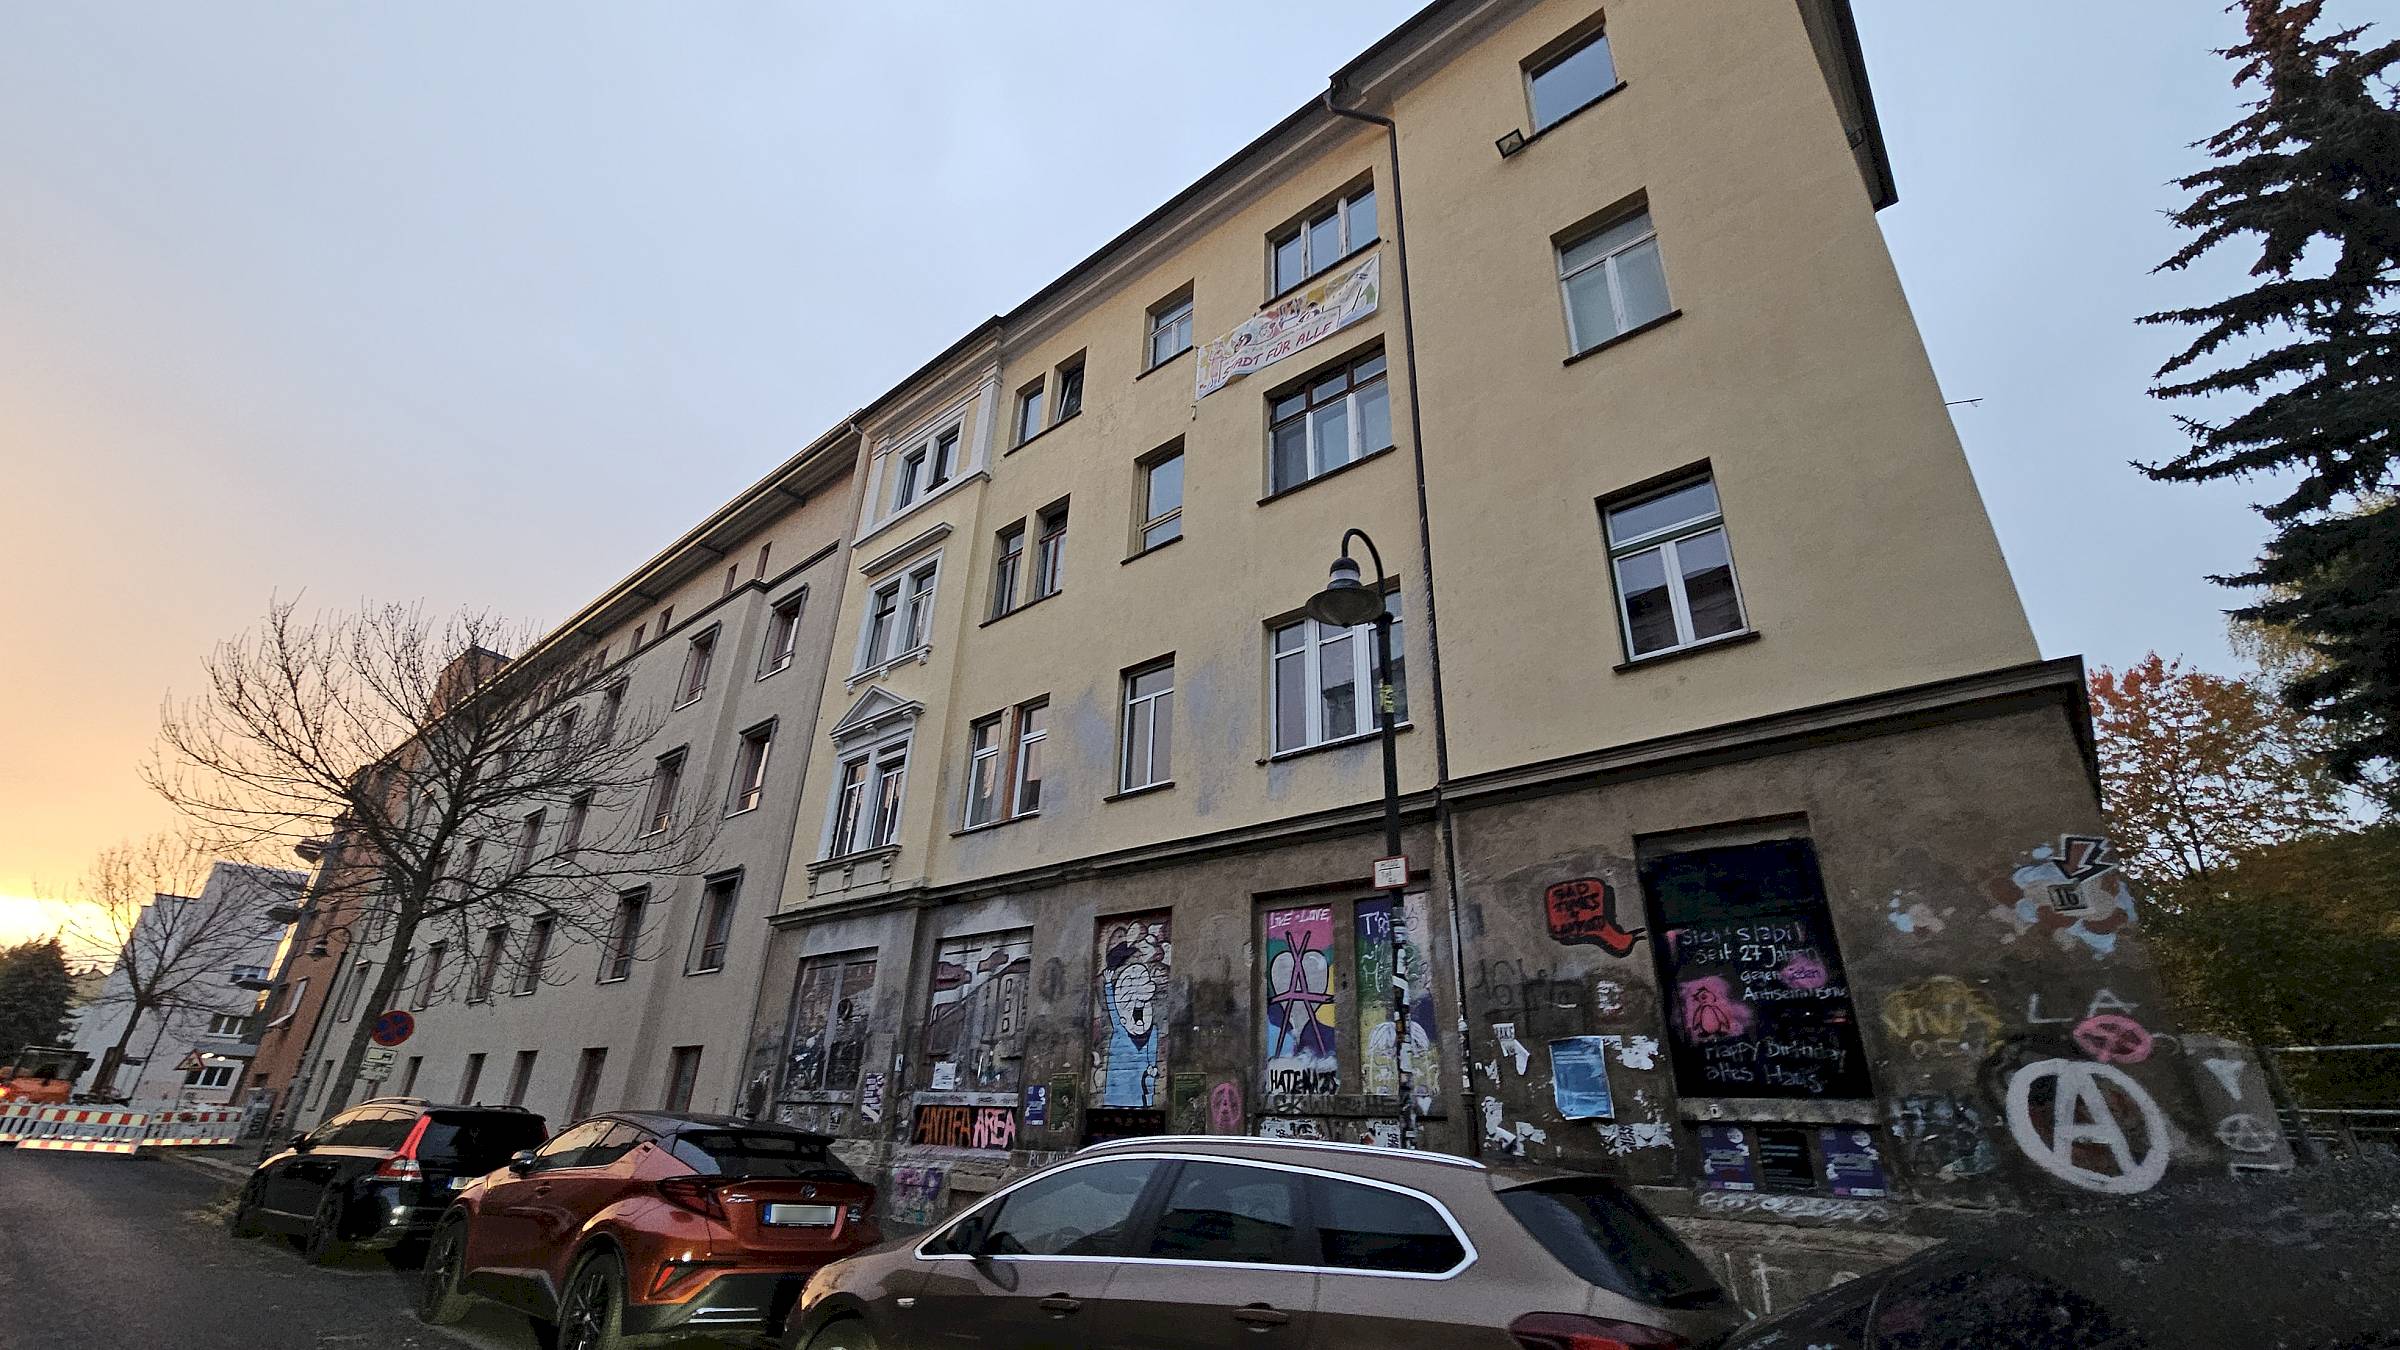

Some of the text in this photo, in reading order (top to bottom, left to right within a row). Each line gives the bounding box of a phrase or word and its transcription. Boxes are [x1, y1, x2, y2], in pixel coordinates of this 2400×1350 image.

[1223, 322, 1332, 374] STADT FÜR ALLE
[1299, 907, 1332, 923] LOVE
[1739, 944, 1763, 962] 27
[916, 1105, 1017, 1150] ANTIFA AREA
